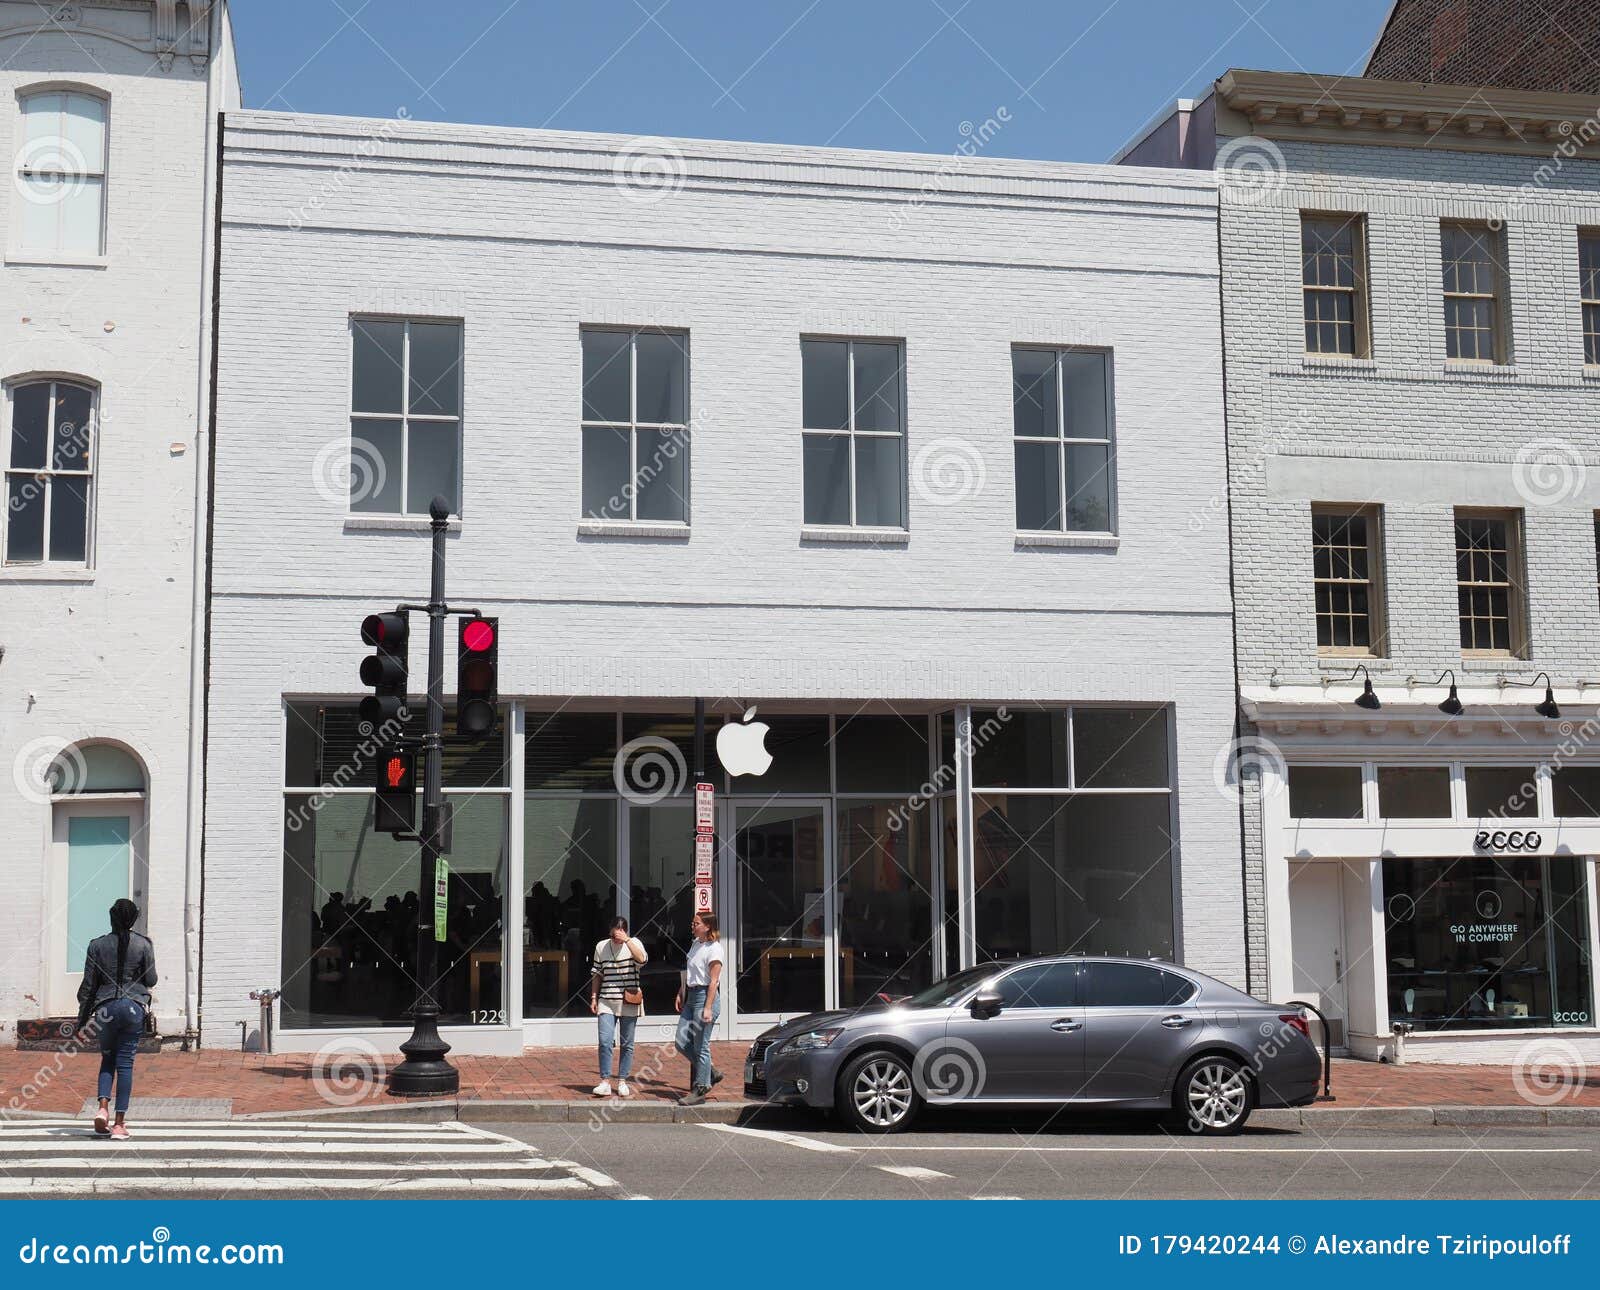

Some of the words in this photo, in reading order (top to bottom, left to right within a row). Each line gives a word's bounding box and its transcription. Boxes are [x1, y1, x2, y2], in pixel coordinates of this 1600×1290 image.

[1450, 925, 1466, 934] GO
[1468, 924, 1518, 934] ANYWHERE
[1455, 934, 1466, 943] IN
[1468, 933, 1514, 943] COMFORT
[470, 1009, 507, 1024] 1229
